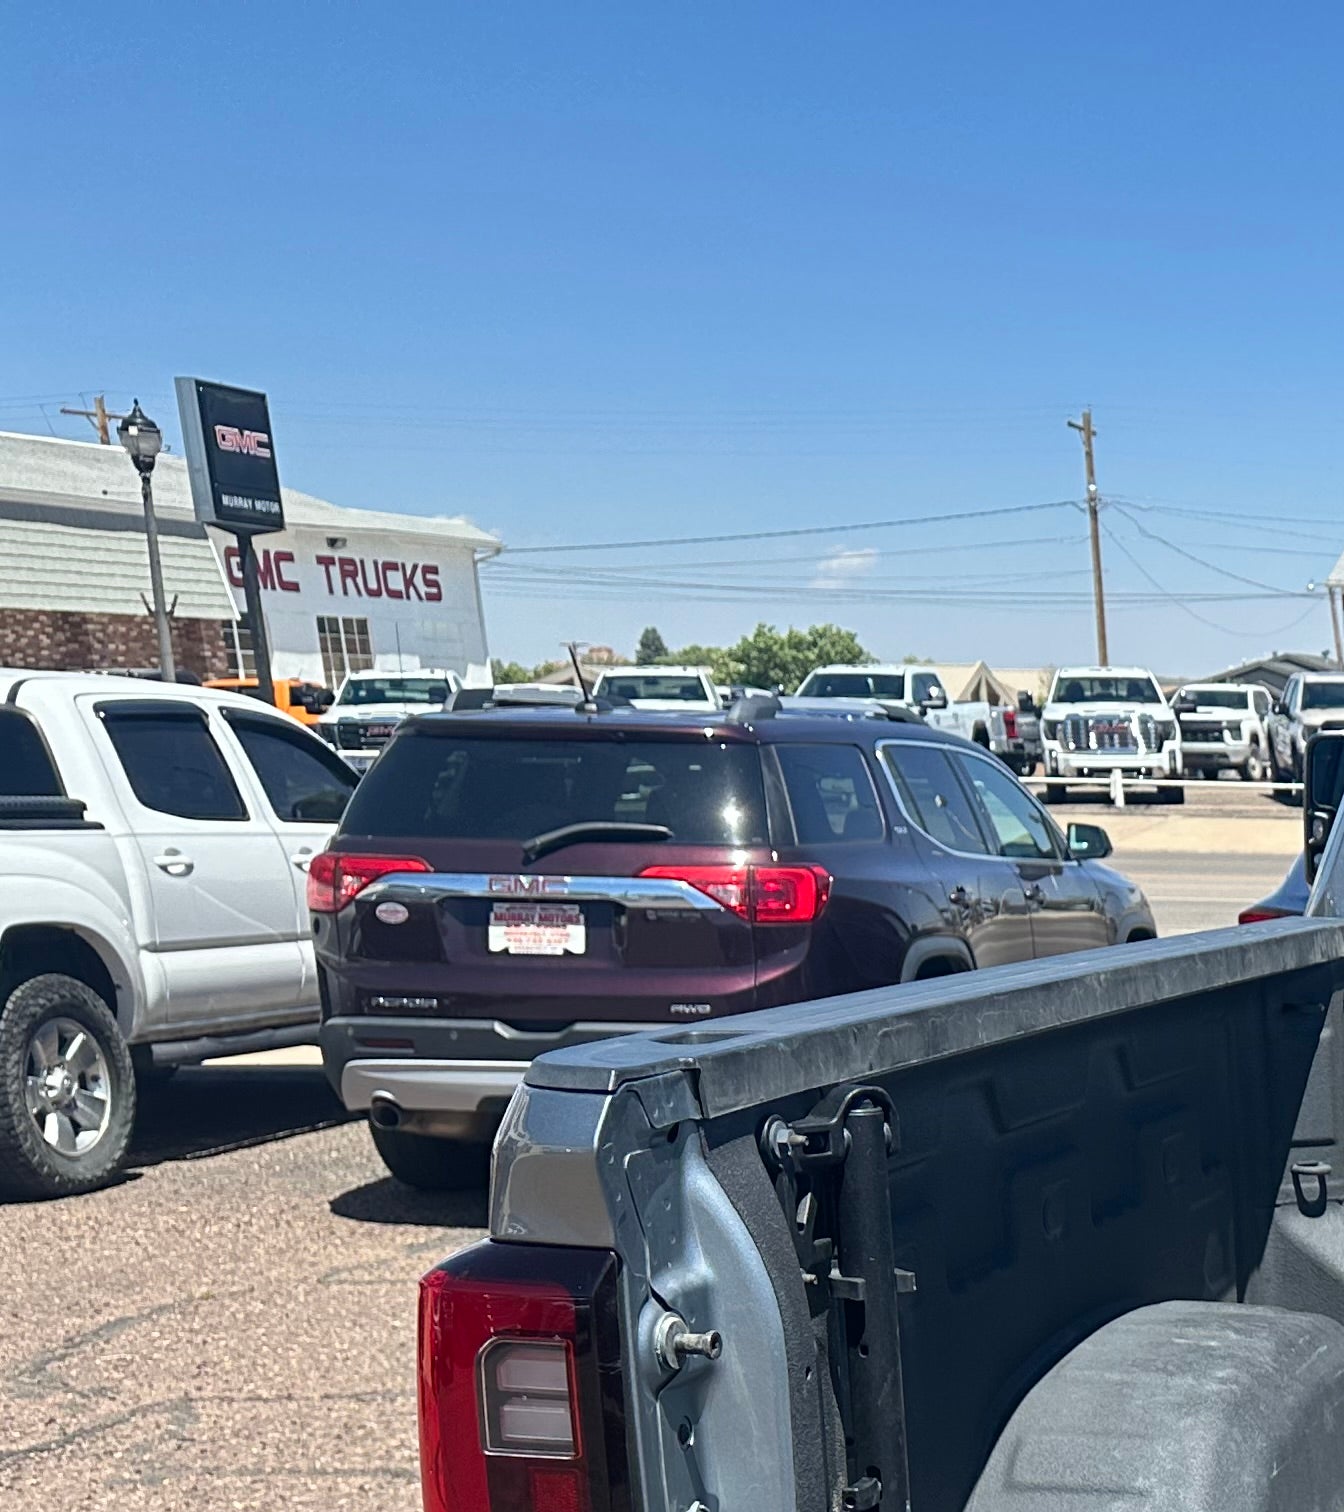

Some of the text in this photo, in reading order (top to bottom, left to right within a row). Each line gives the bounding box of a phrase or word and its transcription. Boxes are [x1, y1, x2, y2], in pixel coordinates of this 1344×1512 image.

[214, 424, 271, 458] GMC
[222, 494, 281, 513] MURRAY MOTOR
[315, 555, 442, 602] TRUCKS
[489, 875, 570, 895] GMC
